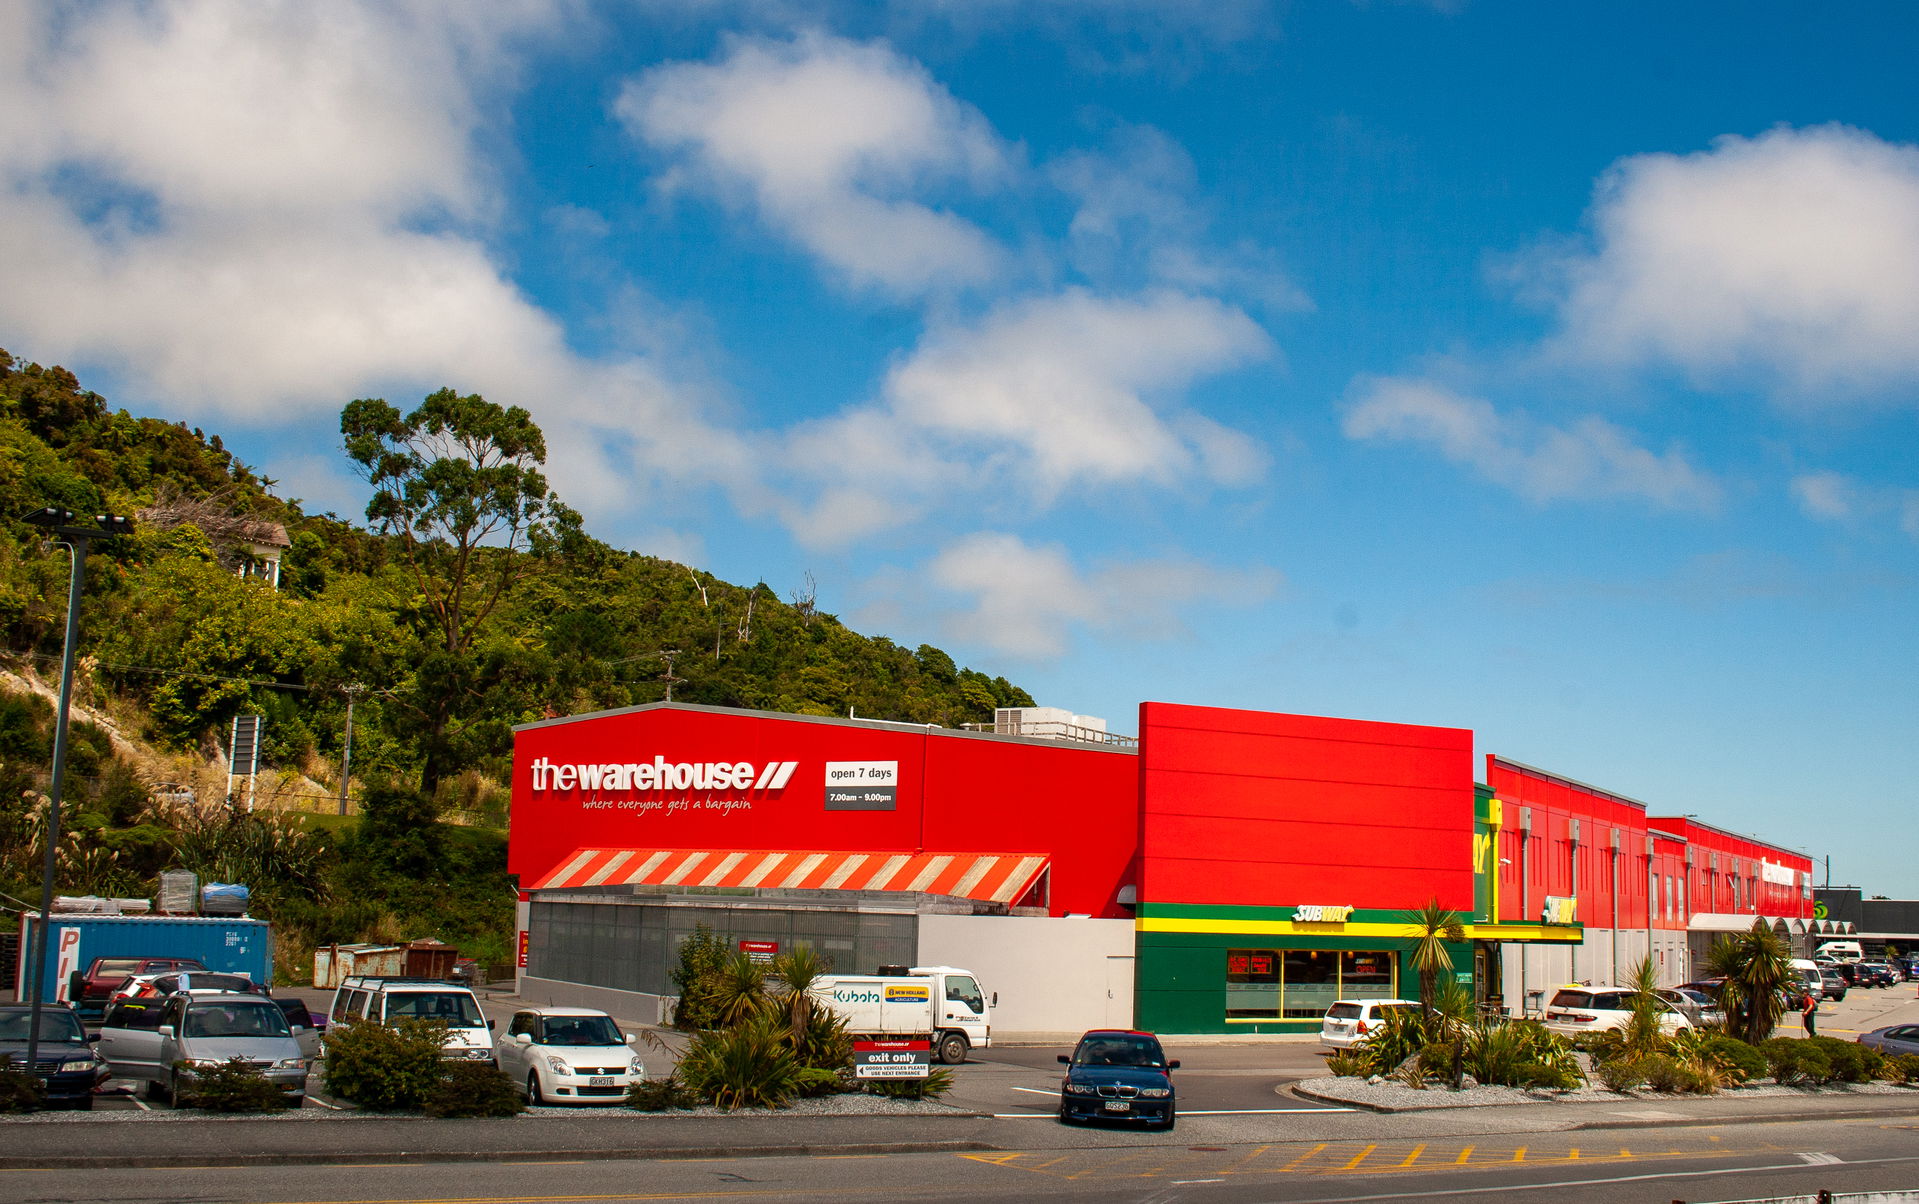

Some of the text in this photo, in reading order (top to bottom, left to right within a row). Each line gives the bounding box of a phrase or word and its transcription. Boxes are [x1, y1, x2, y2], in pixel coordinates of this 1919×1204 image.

[831, 768, 892, 779] open 7 days
[869, 794, 892, 802] 9.00pm
[582, 794, 752, 816] where everyone gets a bargain
[1292, 905, 1354, 922] SUBWAY
[1356, 965, 1377, 975] OPEN
[834, 990, 880, 1003] Kubota
[868, 1052, 916, 1064] exit only
